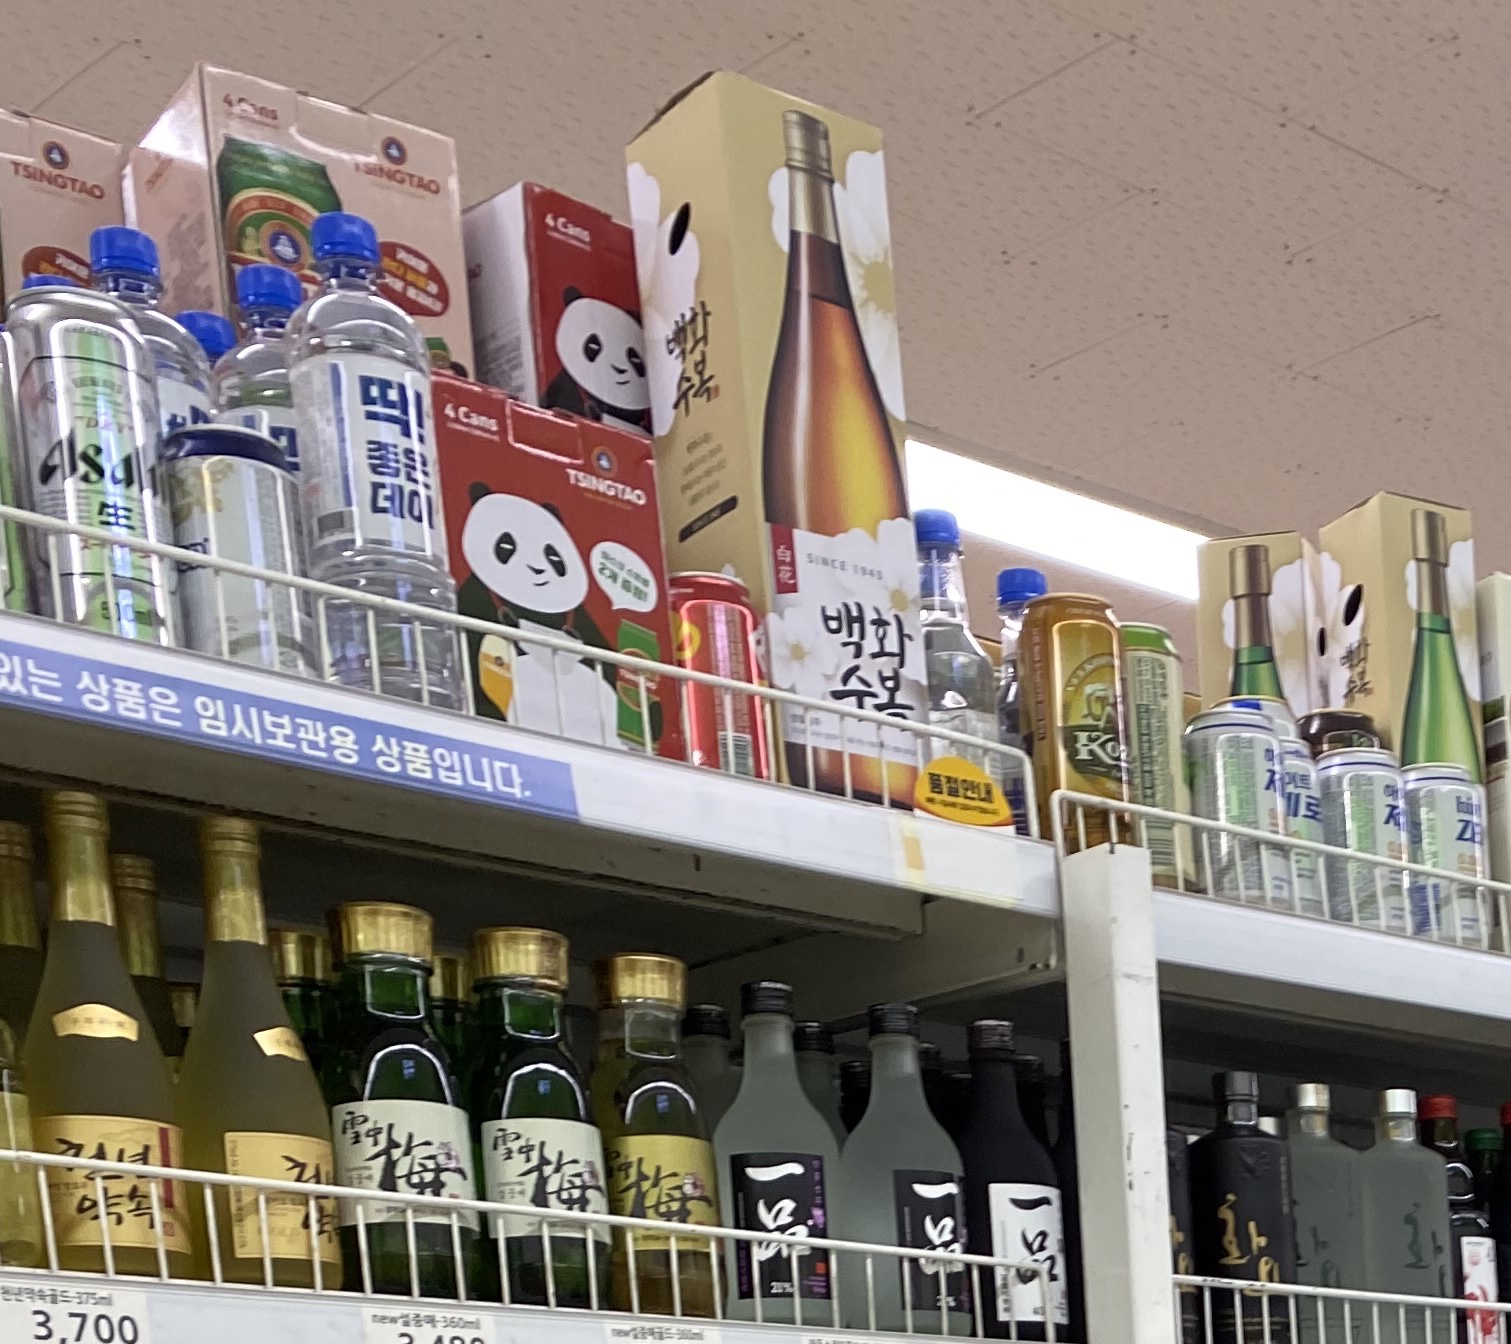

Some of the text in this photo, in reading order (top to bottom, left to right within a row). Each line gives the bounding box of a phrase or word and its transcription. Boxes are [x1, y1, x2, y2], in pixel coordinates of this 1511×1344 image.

[11, 161, 105, 200] TSINGTAO
[359, 374, 425, 443] 딱!
[459, 406, 499, 431] Cans
[367, 440, 431, 480] 좋은
[370, 481, 434, 530] 데이
[566, 470, 646, 506] TSINGTAO
[806, 551, 848, 575] SINCE
[821, 600, 911, 669] 백화
[829, 667, 917, 722] 수복
[76, 671, 181, 724] 상품은
[195, 697, 359, 764] 임시보관용
[372, 733, 532, 798] 상품입니다.
